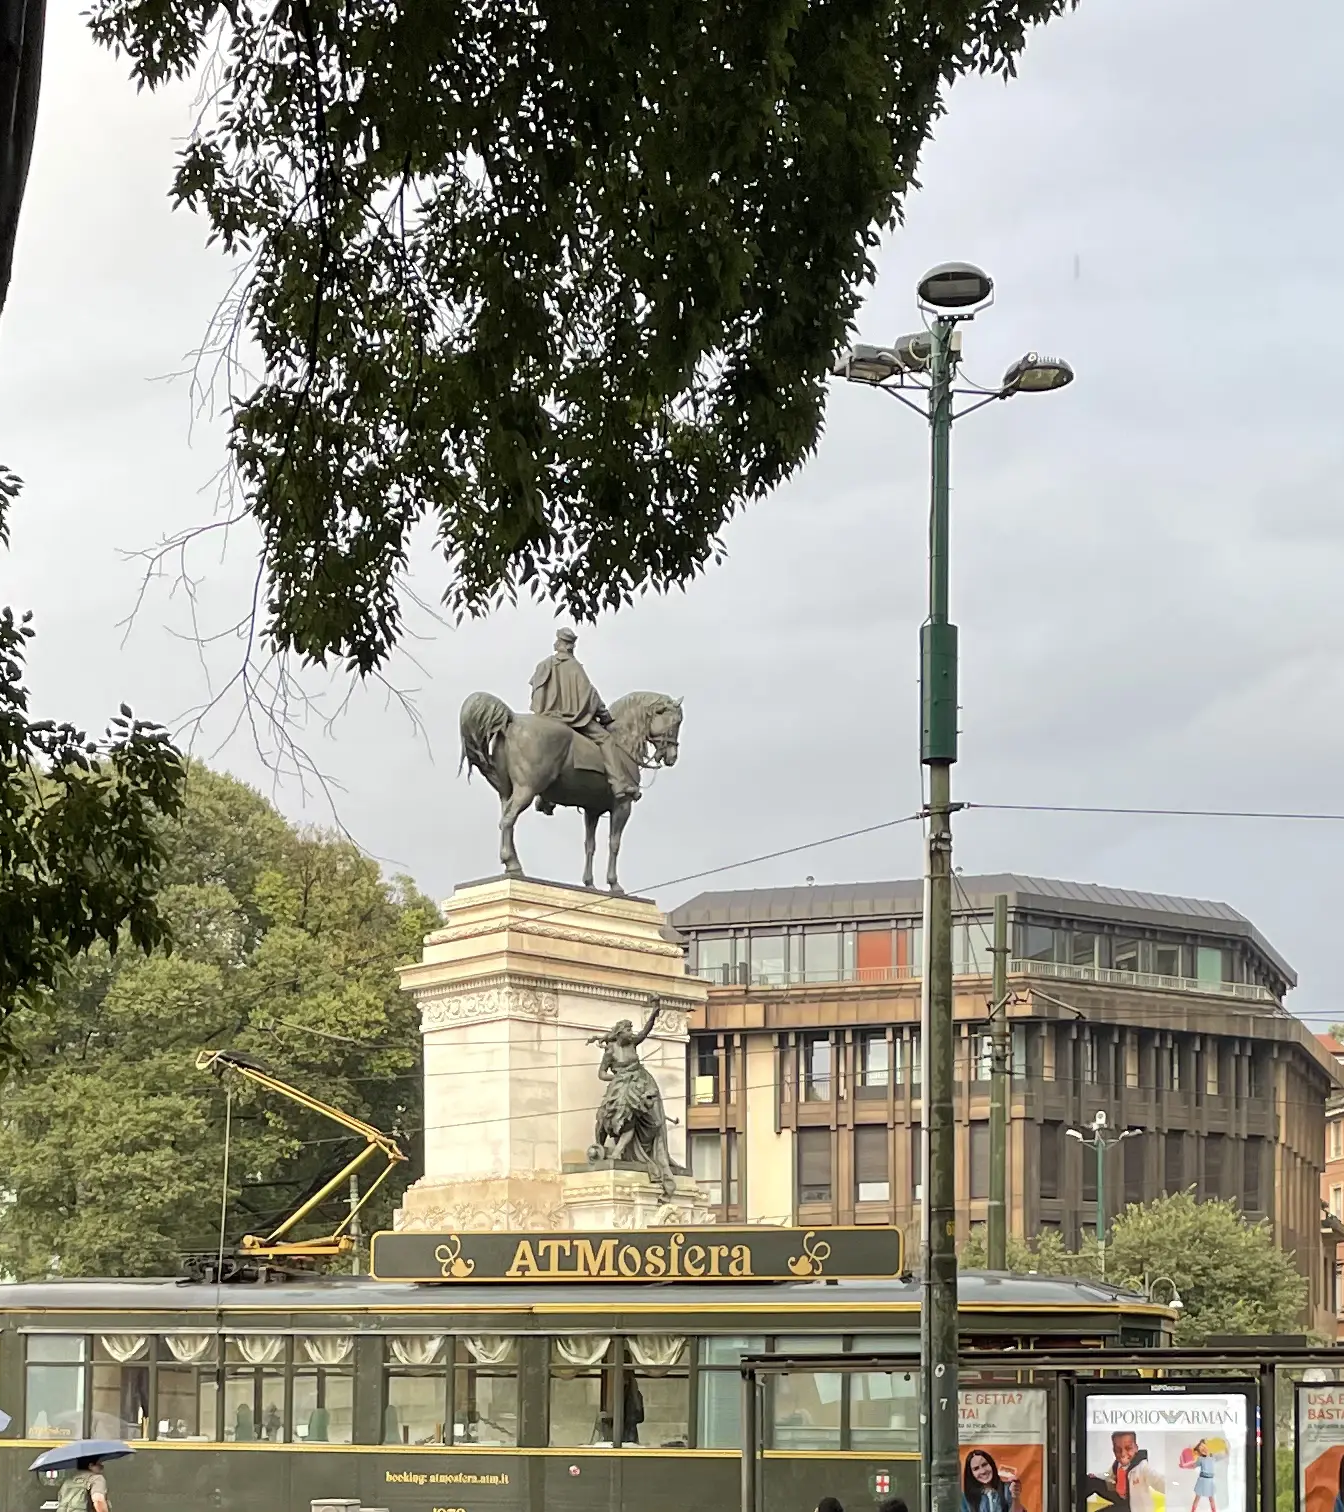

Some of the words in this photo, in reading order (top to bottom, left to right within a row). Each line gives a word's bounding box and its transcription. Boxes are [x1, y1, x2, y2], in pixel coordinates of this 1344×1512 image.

[505, 1232, 755, 1276] ATMosfera
[964, 1394, 973, 1405] E
[976, 1393, 1023, 1405] GETTA?
[1307, 1393, 1335, 1405] USA
[1092, 1410, 1159, 1425] EMPORIO
[1181, 1409, 1239, 1425] ARMANI
